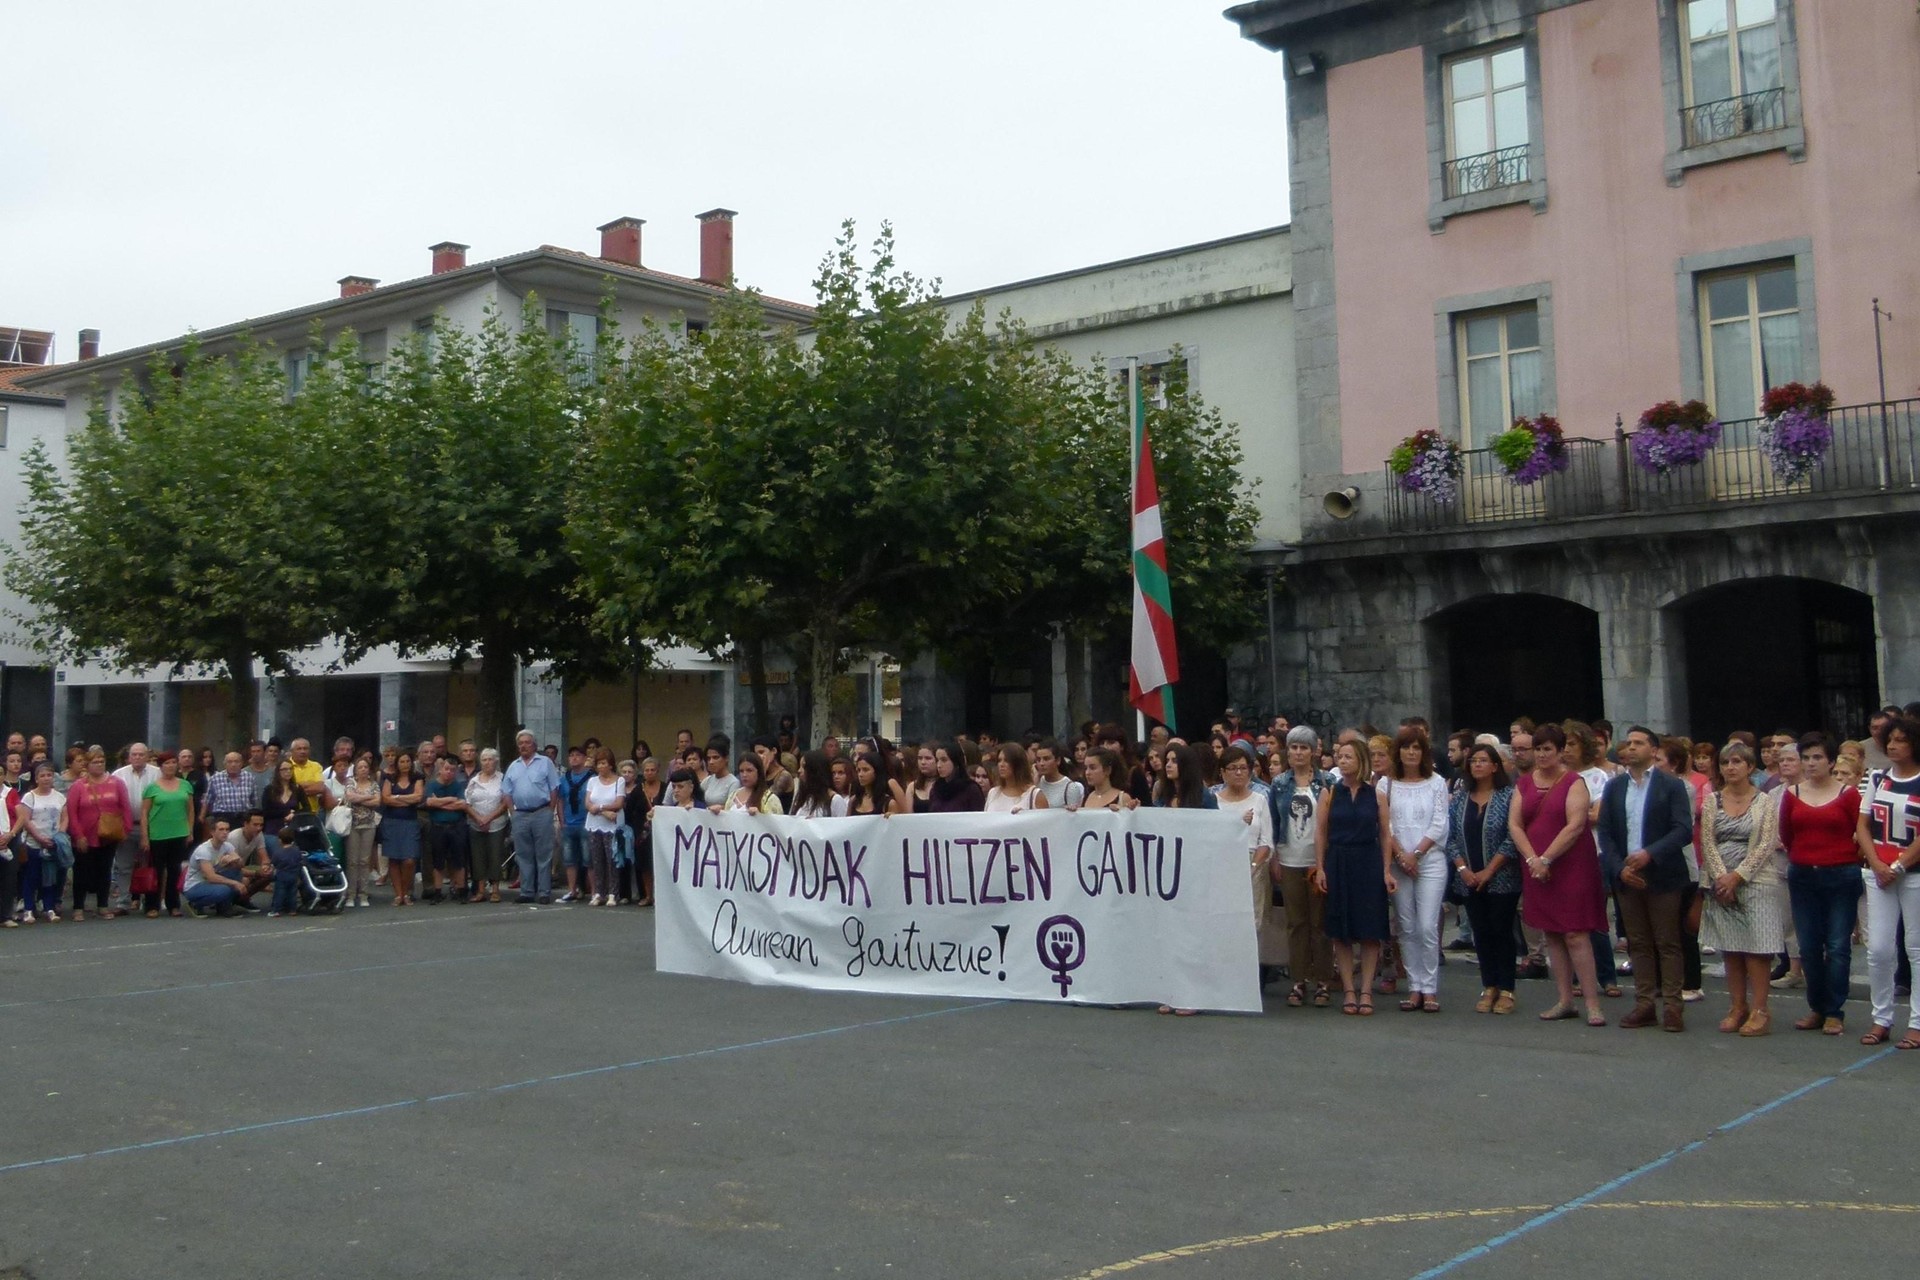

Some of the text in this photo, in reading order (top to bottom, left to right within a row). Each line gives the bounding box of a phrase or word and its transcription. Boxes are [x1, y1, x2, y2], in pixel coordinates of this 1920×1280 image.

[672, 824, 1184, 908] MATXISMOAK HILTZEN GAITU
